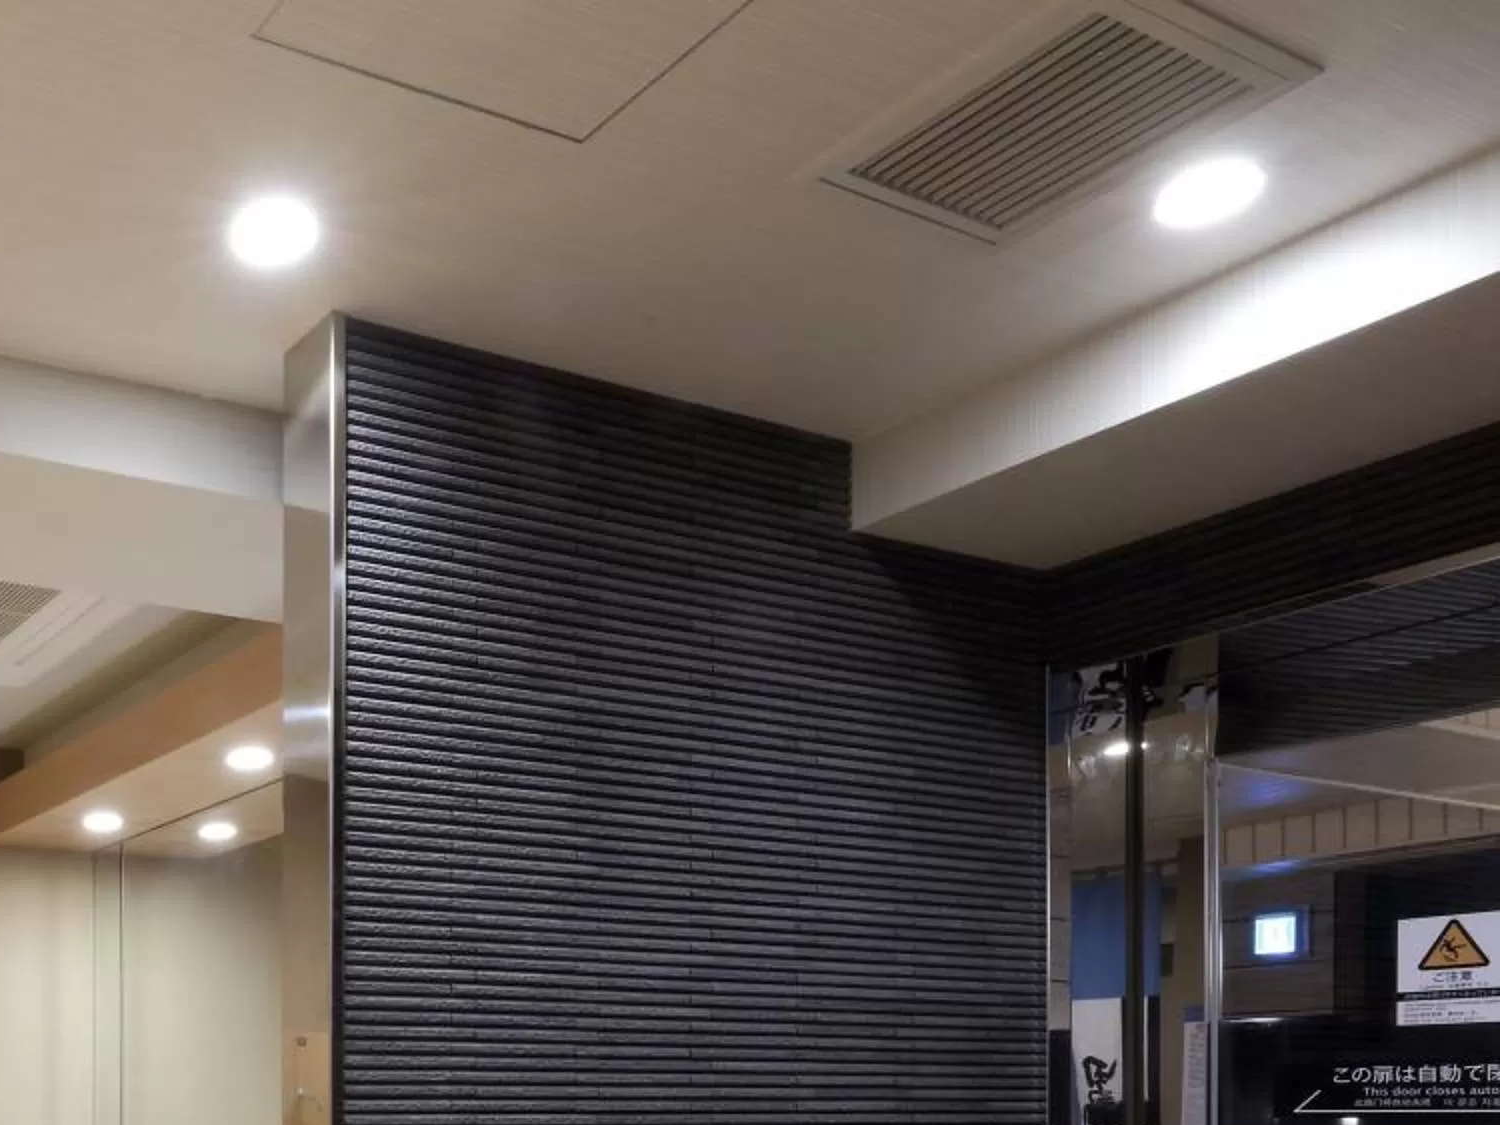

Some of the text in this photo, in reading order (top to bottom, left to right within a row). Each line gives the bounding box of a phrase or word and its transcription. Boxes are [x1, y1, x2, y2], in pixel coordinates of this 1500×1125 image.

[1364, 1086, 1389, 1097] This
[1393, 1086, 1422, 1096] door
[1426, 1085, 1466, 1096] closes
